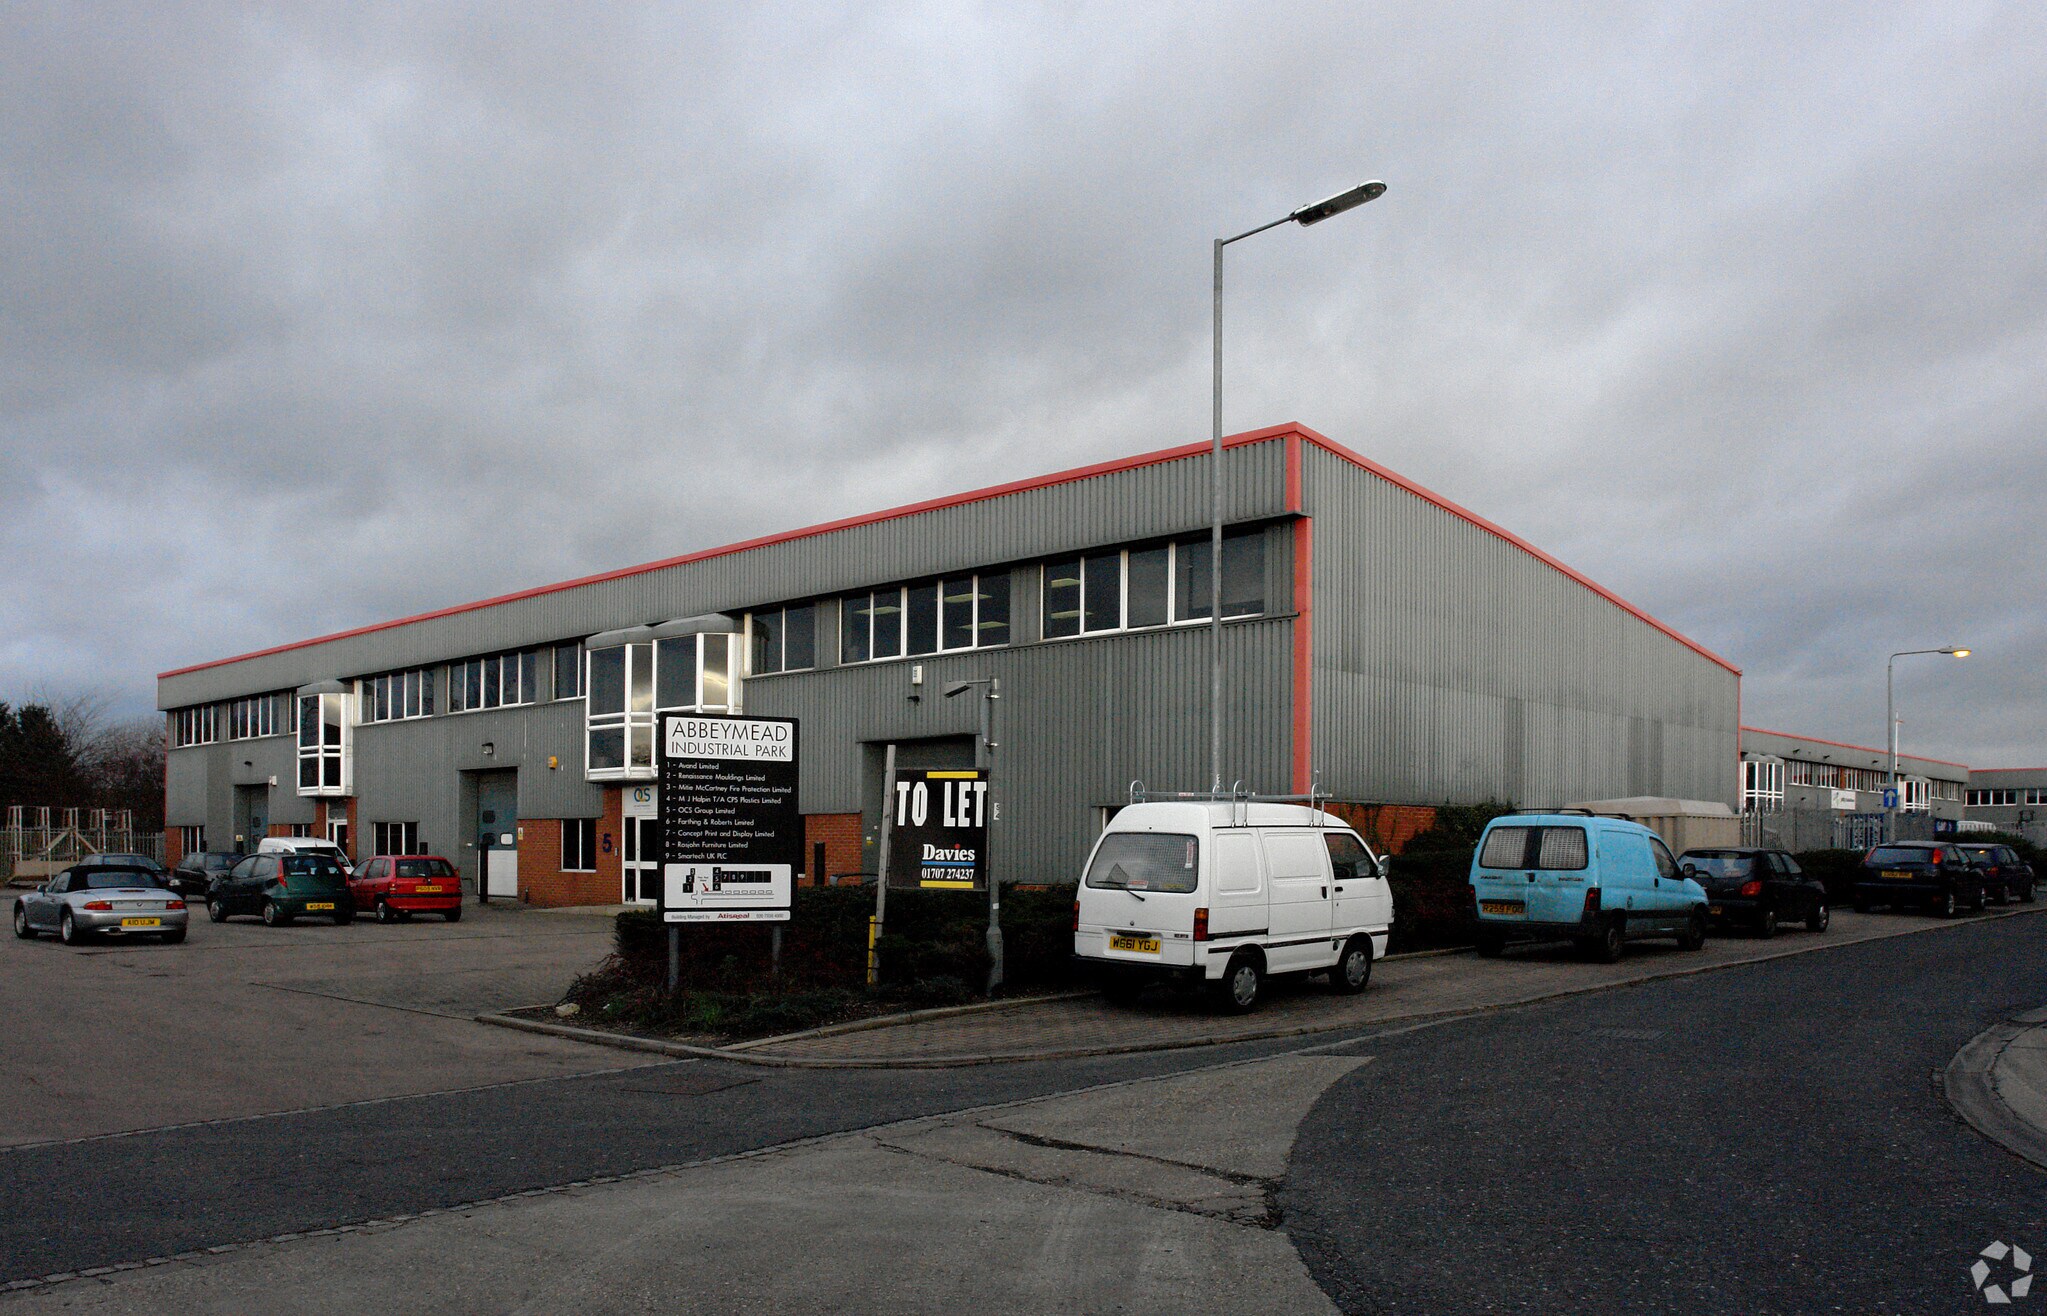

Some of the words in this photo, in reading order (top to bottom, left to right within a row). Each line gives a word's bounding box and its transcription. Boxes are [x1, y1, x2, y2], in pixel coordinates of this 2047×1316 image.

[672, 721, 788, 742] ABBEYMEAD
[671, 741, 749, 756] INDUSTRIAL
[756, 744, 786, 758] PARK
[695, 785, 727, 793] McCartney
[896, 782, 928, 826] TO
[943, 782, 987, 827] LET
[603, 833, 612, 853] 5
[922, 843, 976, 861] Davies
[921, 868, 945, 879] 01707
[946, 868, 974, 880] 274237
[1138, 940, 1158, 951] YGJ
